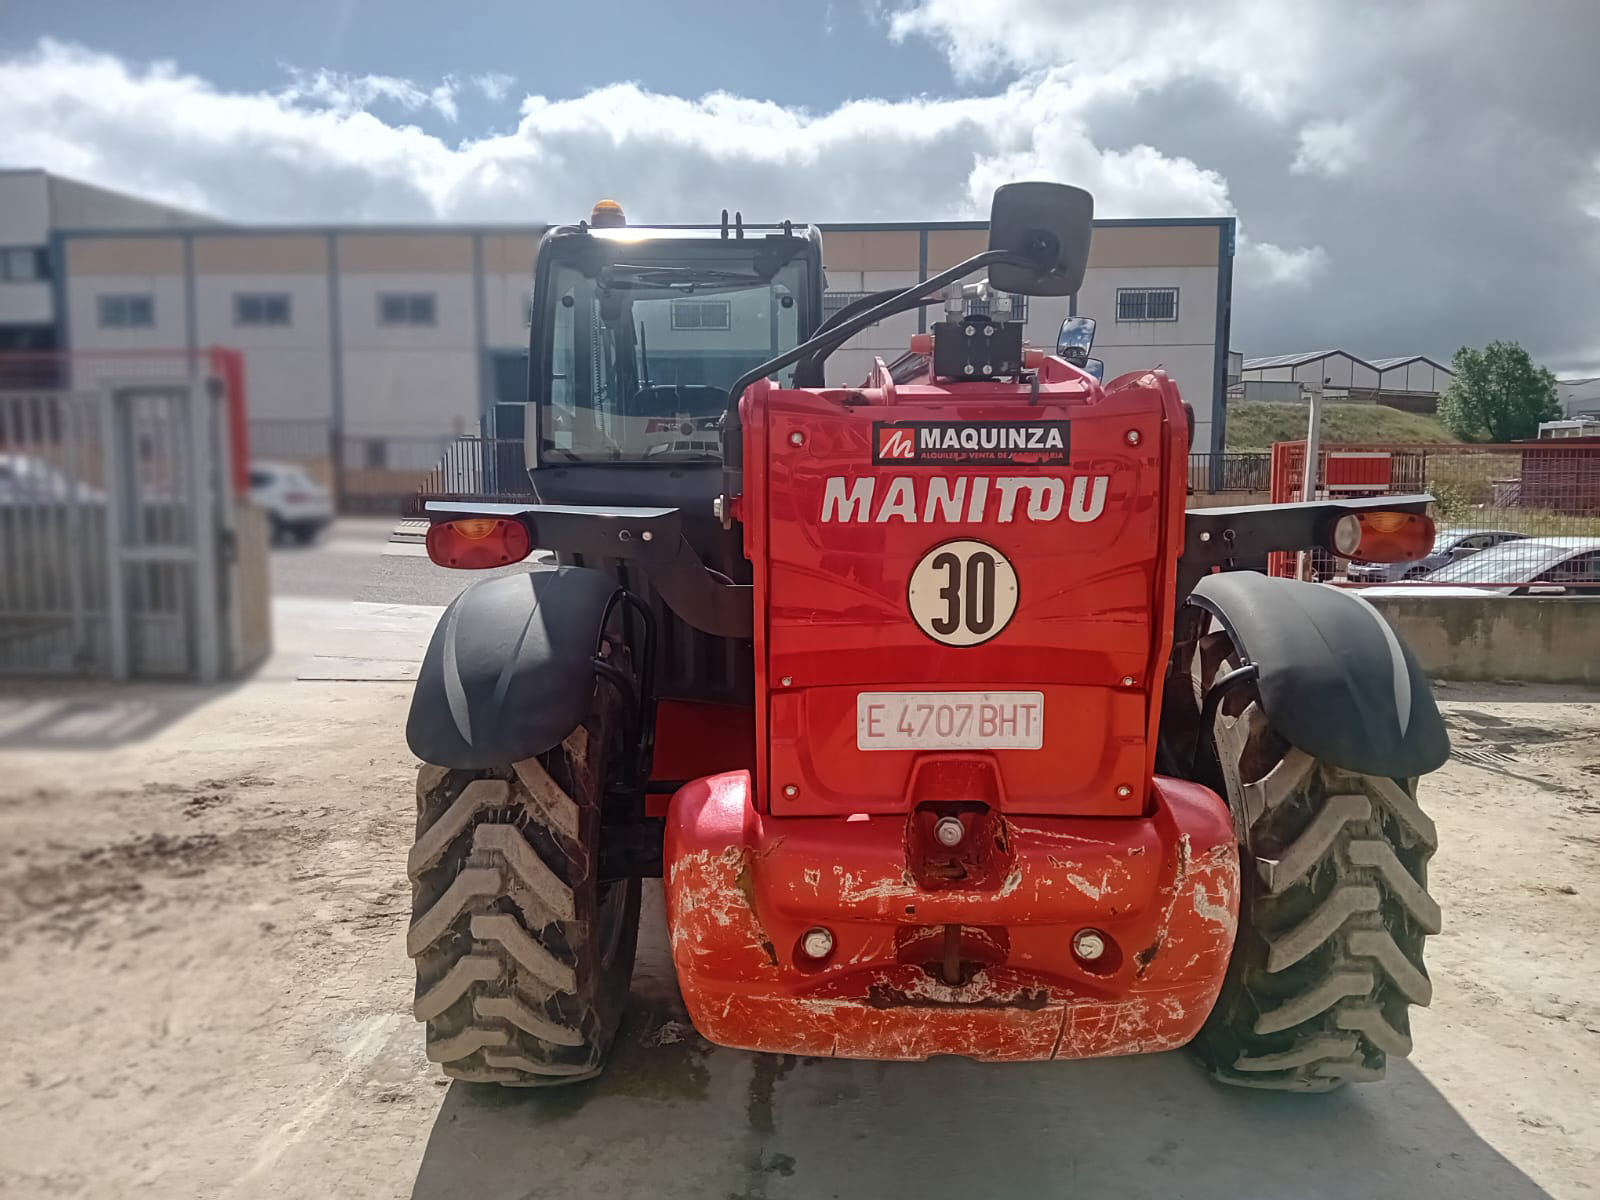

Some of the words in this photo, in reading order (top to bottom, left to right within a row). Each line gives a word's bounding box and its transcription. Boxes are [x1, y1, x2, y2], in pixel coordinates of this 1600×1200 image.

[920, 427, 1064, 450] MAQUINZA
[821, 476, 1109, 523] MANITOU
[931, 551, 996, 635] 30
[867, 704, 885, 737] E
